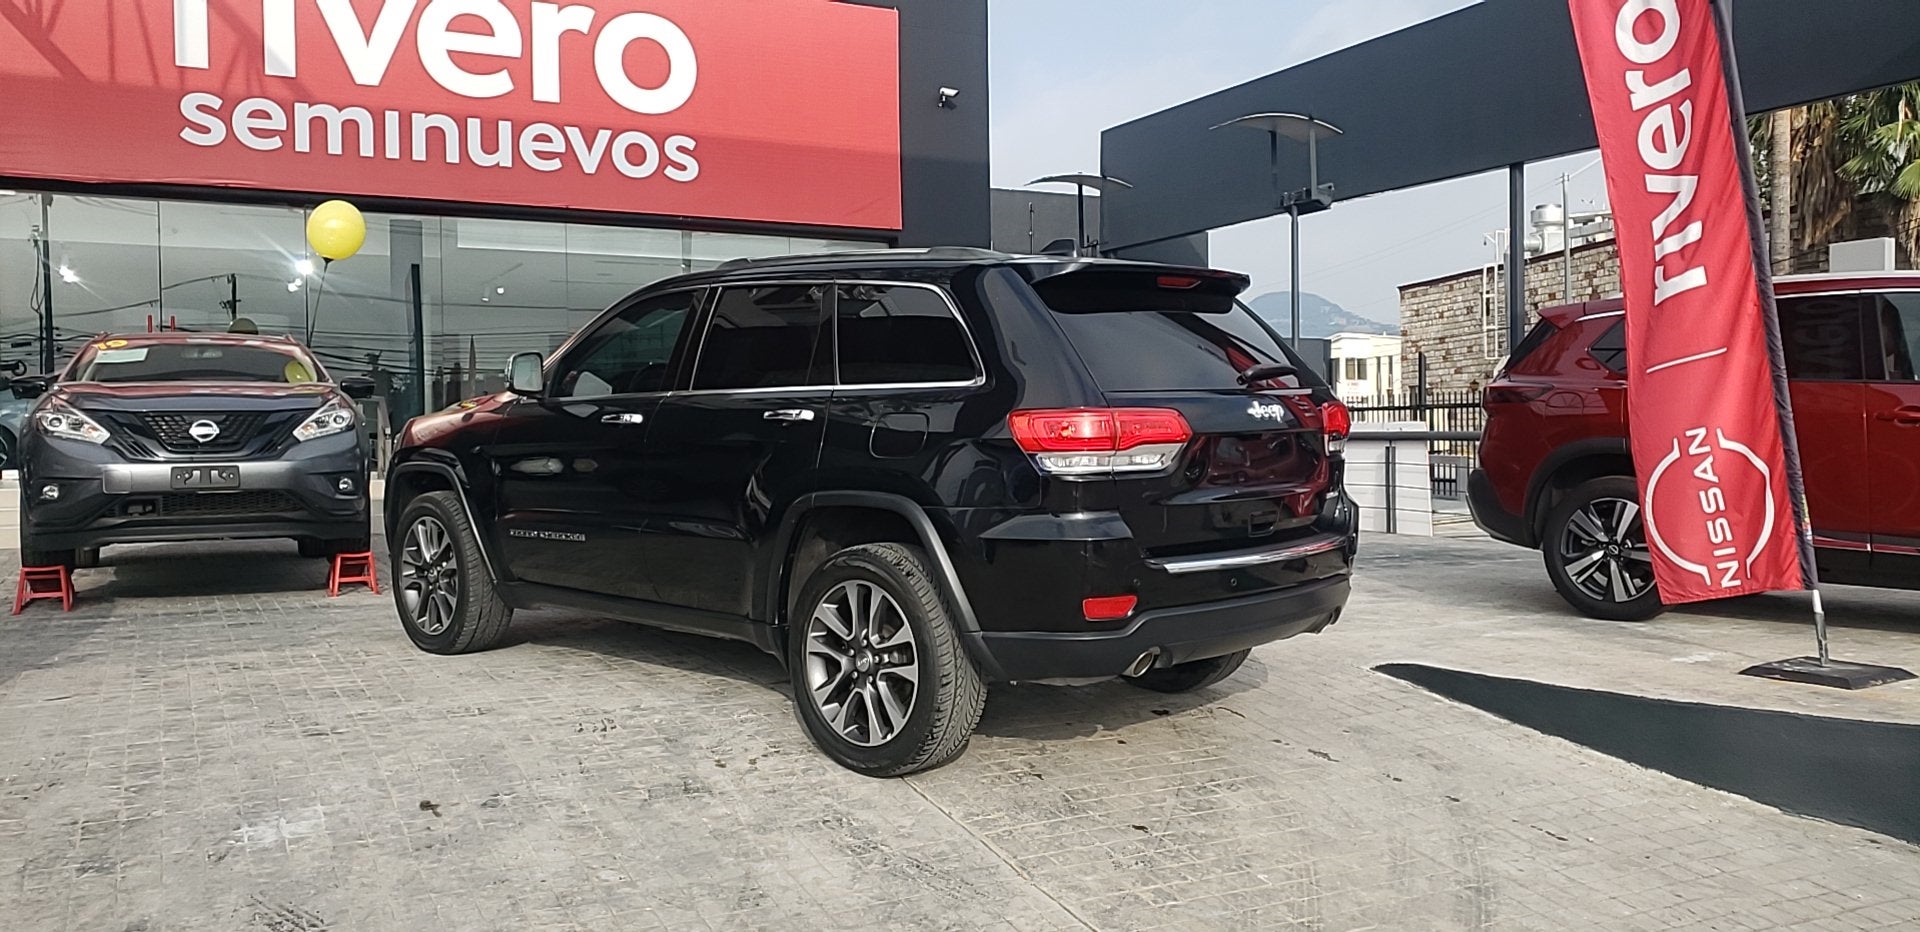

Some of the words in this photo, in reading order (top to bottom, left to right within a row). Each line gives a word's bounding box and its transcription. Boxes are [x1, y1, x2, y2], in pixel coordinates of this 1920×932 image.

[180, 93, 699, 183] seminuevos
[1616, 0, 1707, 306] rivero
[1247, 400, 1285, 423] Jeep
[1686, 426, 1742, 588] NISSAN
